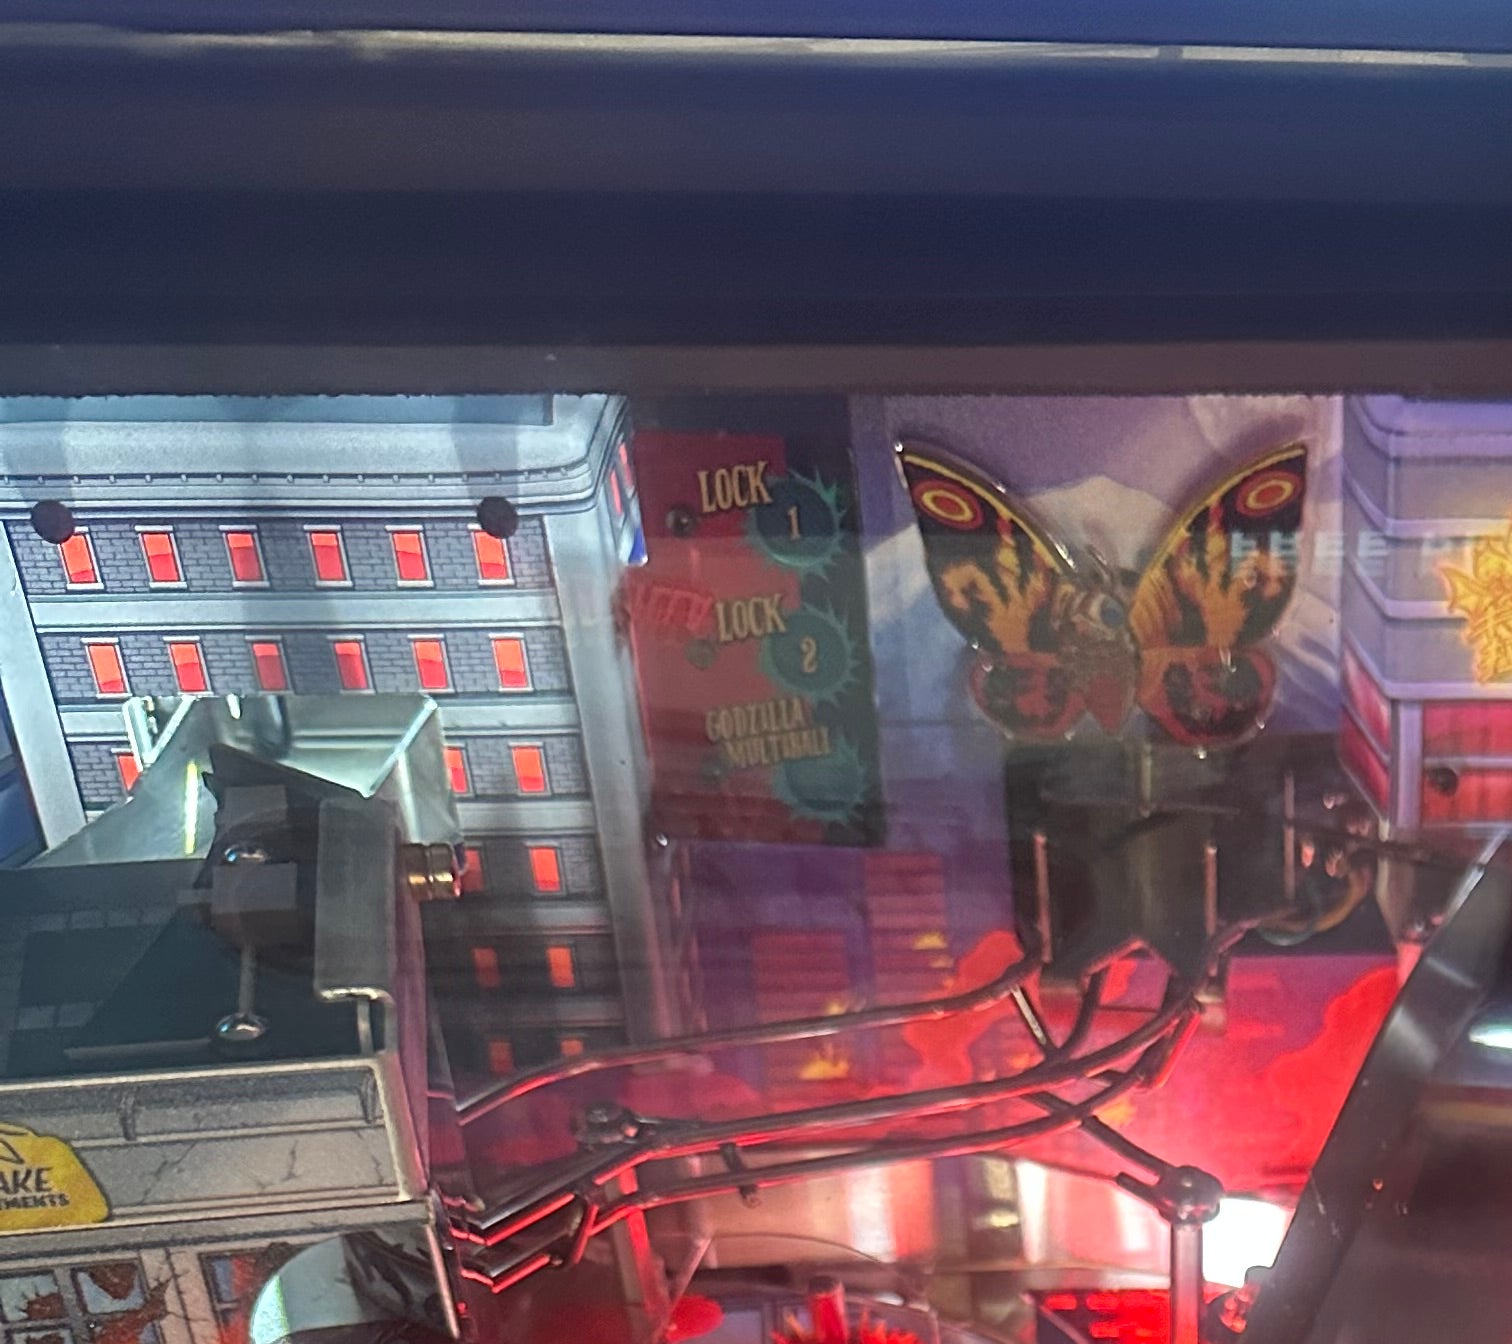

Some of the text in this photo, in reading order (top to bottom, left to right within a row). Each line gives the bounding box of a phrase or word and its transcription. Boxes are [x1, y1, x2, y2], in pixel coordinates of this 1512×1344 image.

[697, 460, 800, 540] LOCK 1
[714, 593, 788, 642] LOCK
[801, 637, 818, 674] 2
[705, 697, 808, 742] GODZILLA
